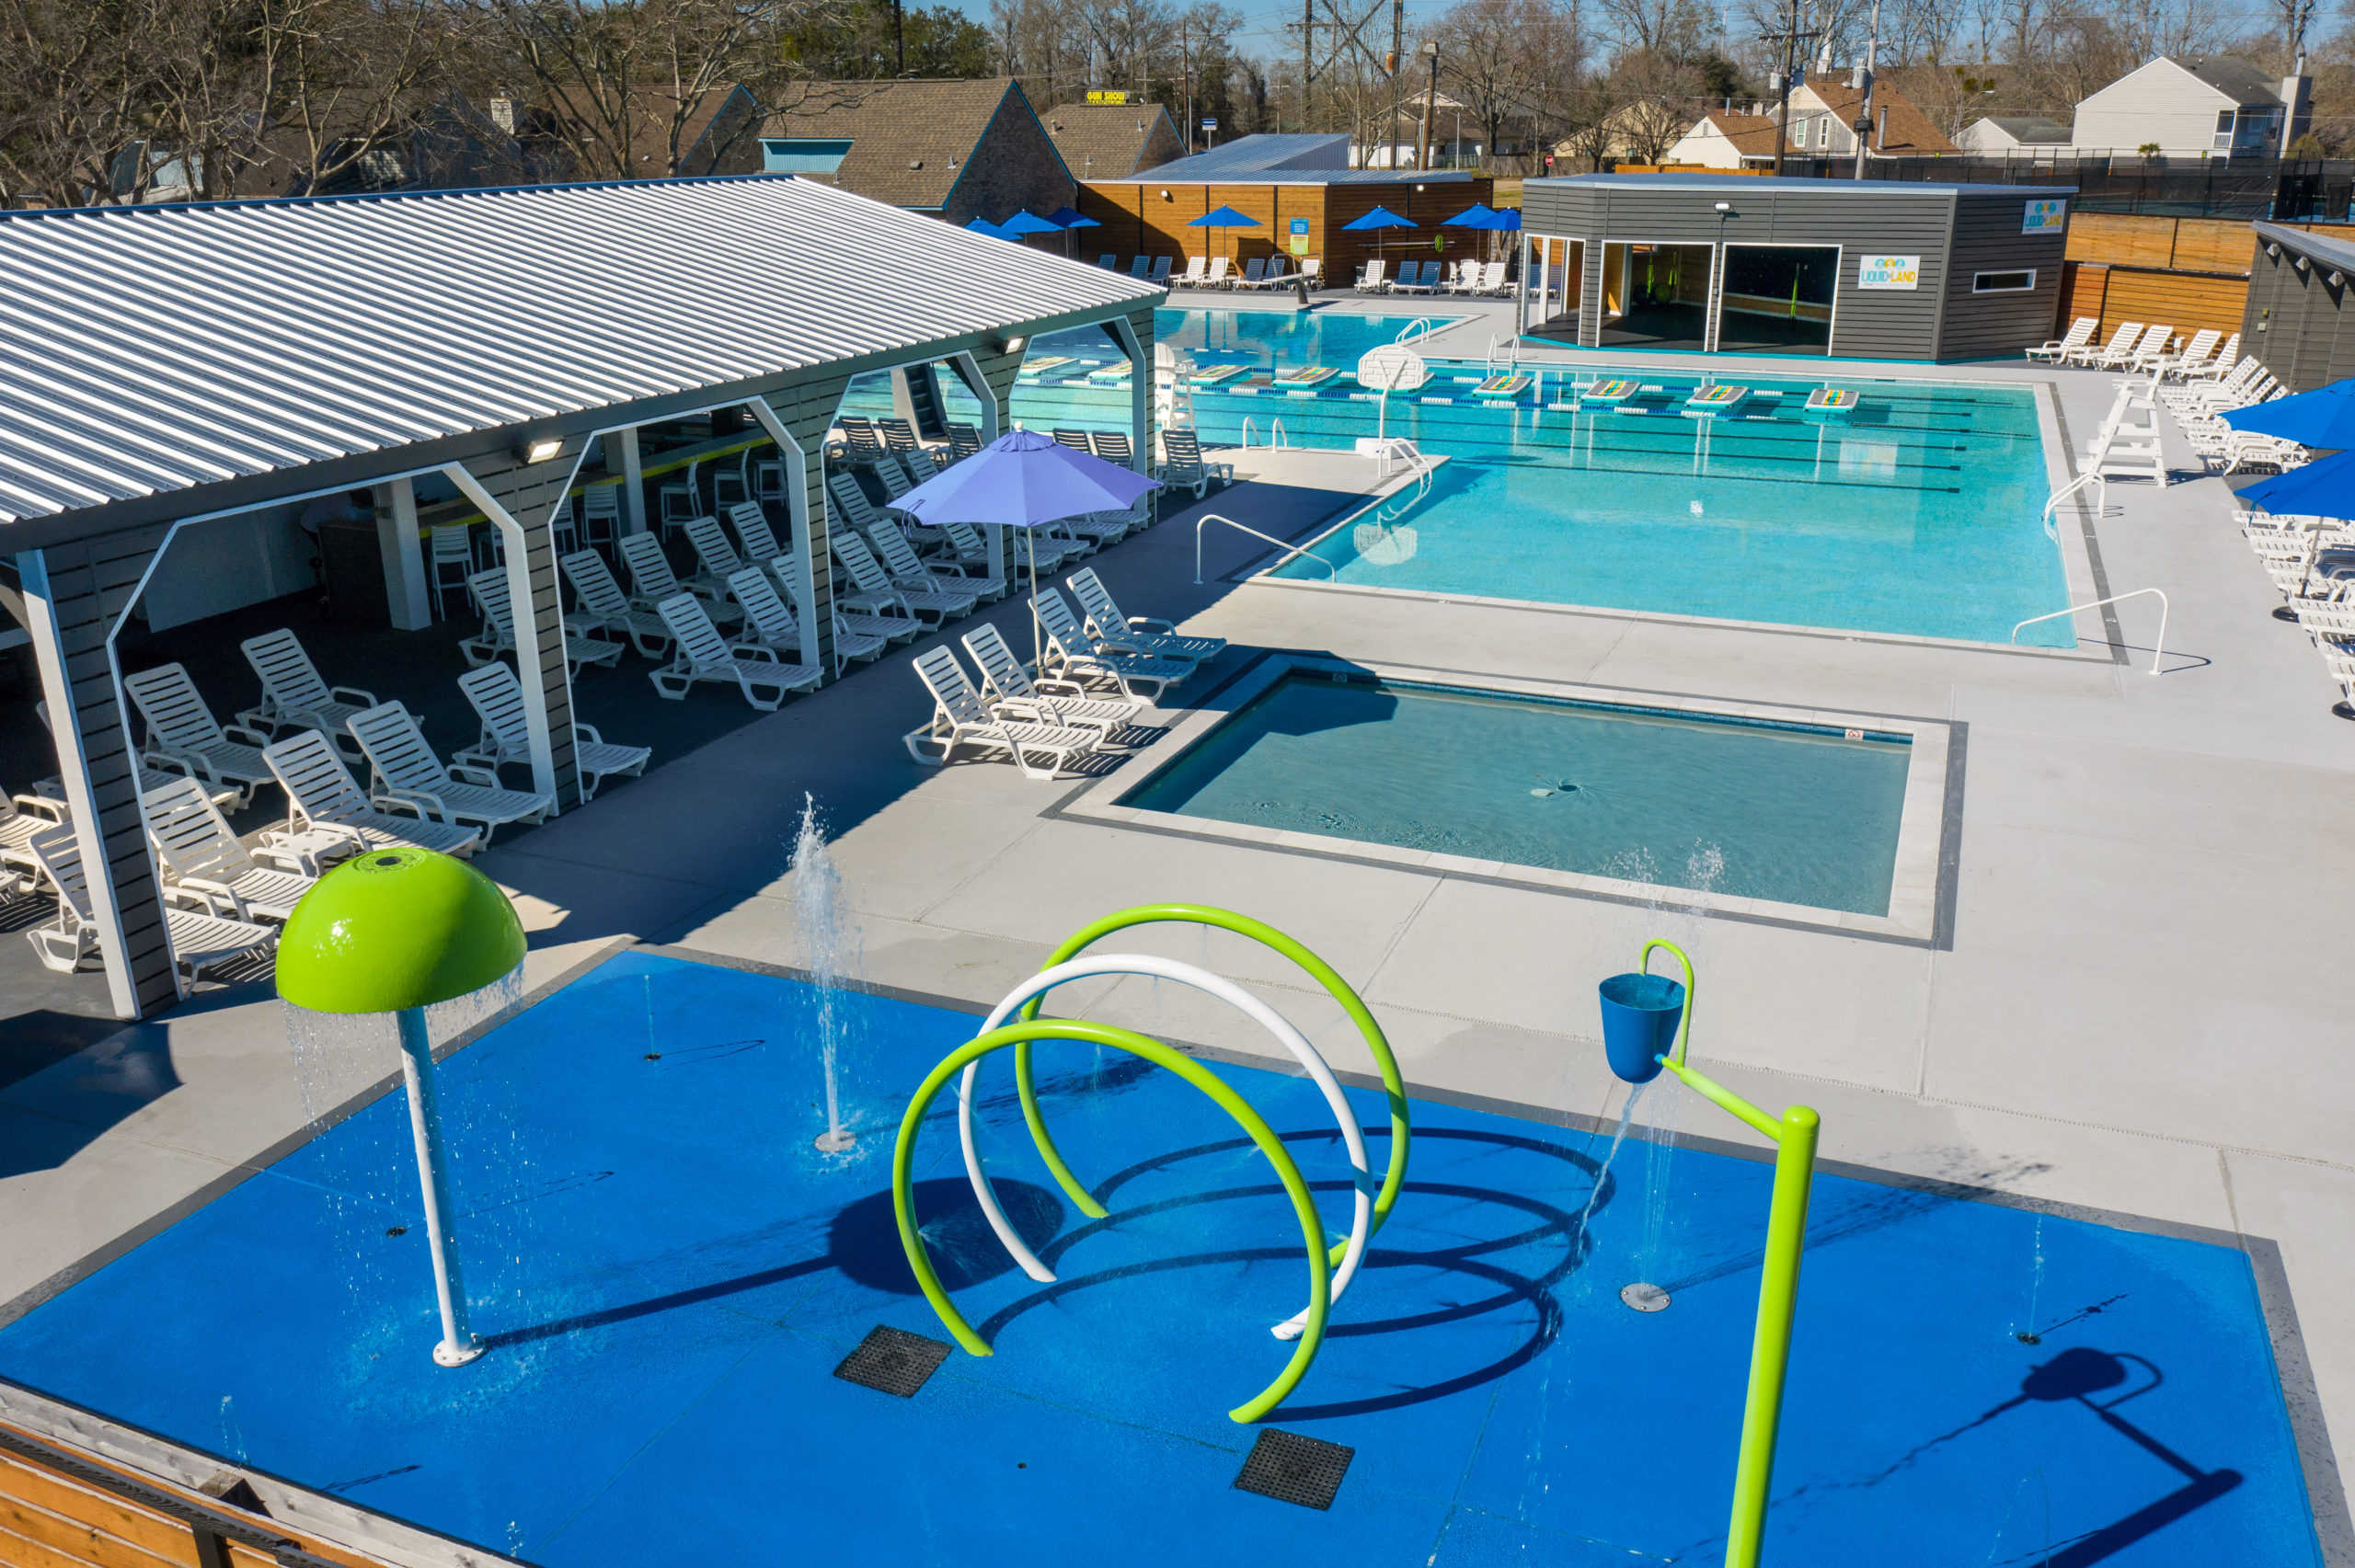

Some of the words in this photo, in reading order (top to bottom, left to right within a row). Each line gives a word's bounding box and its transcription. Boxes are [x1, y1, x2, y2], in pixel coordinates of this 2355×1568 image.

[1086, 91, 1102, 100] GUN
[1104, 91, 1125, 100] SHOW
[2044, 214, 2062, 226] LAND
[1861, 270, 1888, 282] LIQUID
[1890, 270, 1915, 282] LAND
